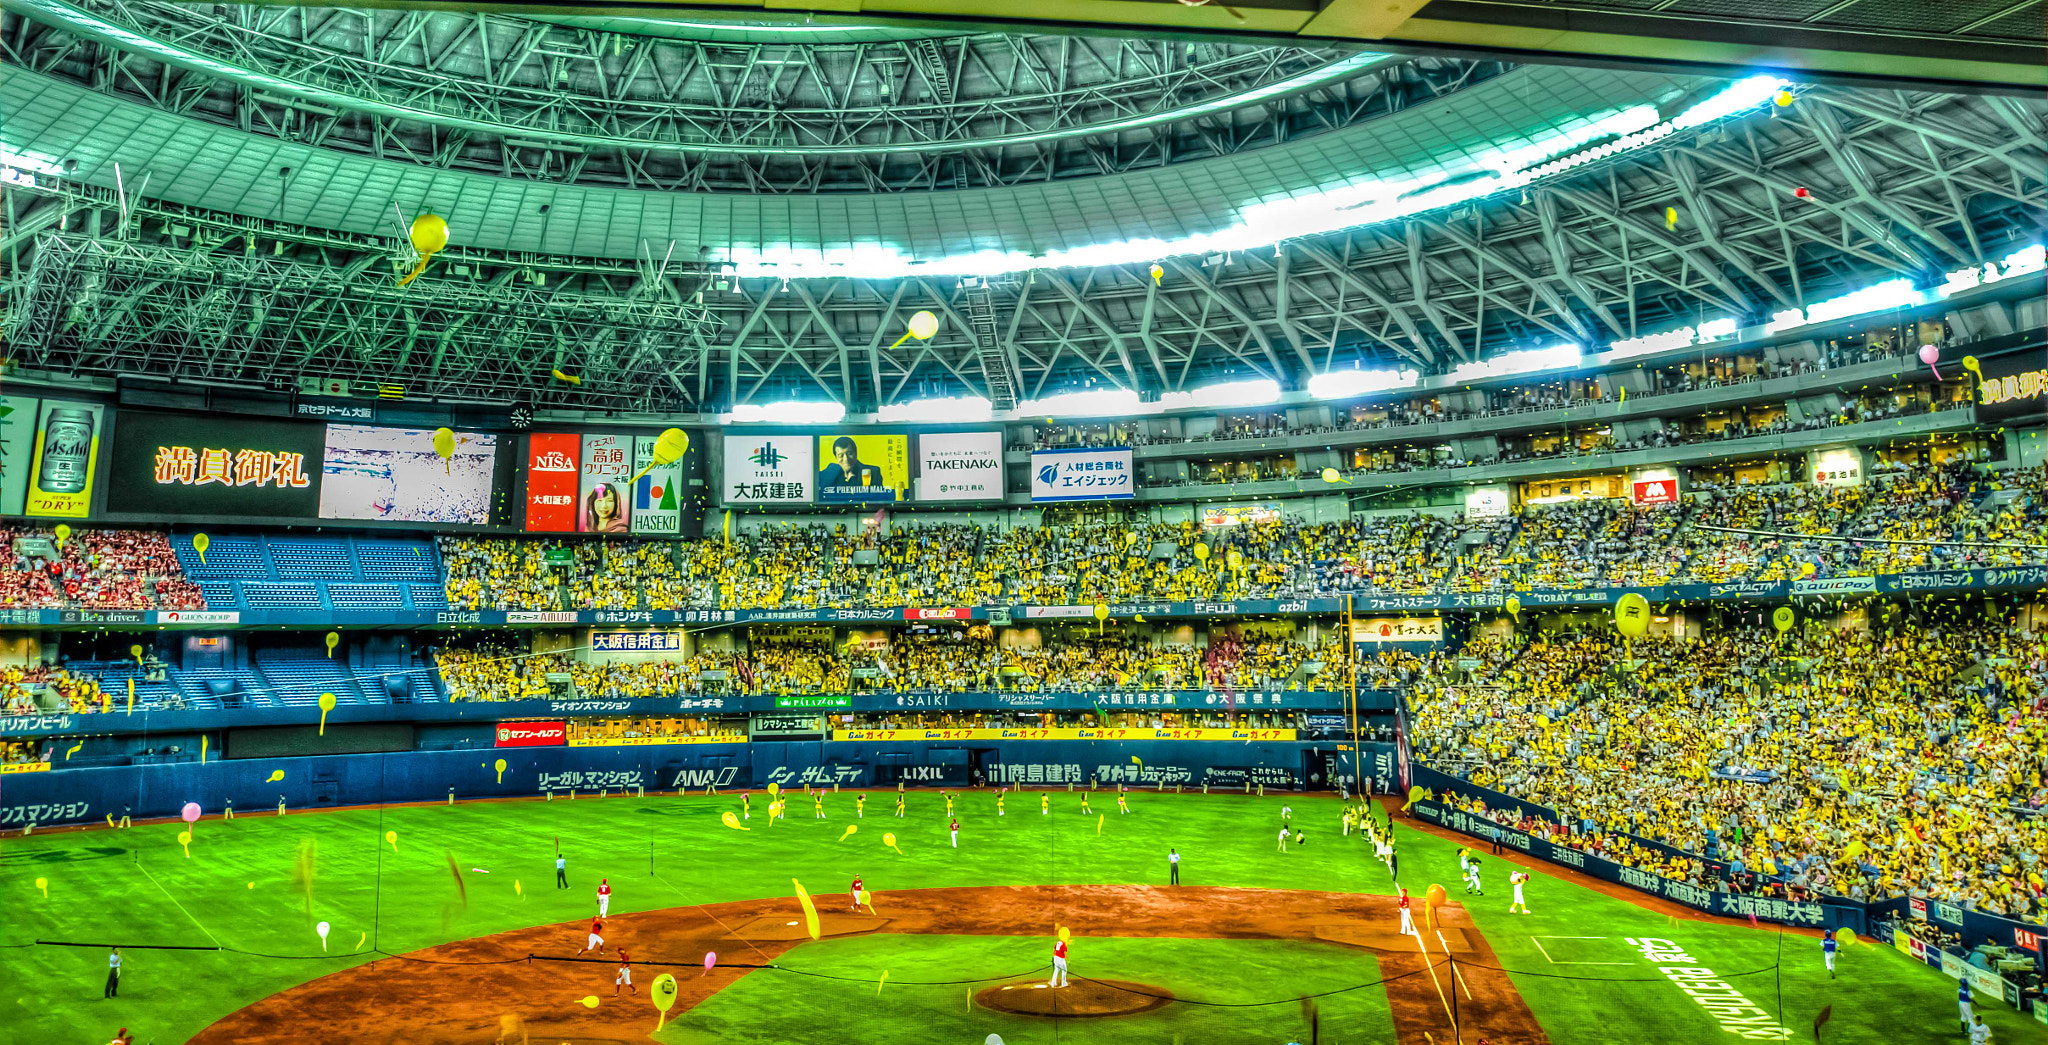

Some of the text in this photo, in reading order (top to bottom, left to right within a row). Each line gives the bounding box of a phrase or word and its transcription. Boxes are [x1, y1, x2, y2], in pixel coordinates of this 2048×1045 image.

[298, 404, 372, 418] 京セラドーム大阪
[47, 439, 88, 457] Asahi
[593, 448, 624, 463] 高須
[155, 446, 310, 488] 満員御礼
[536, 455, 573, 469] NISA
[926, 459, 998, 470] TAKENAKA
[1066, 461, 1124, 472] 人材総合商社
[584, 463, 629, 475] クリニック
[1063, 474, 1128, 487] エイジェック
[734, 482, 804, 499] 大成建設
[836, 485, 870, 494] PREMIUM
[533, 495, 572, 505] 大和証券
[635, 515, 677, 530] HASEKO
[1806, 581, 1874, 590] QUICPay
[1902, 572, 1971, 588] 日本カルミック
[1278, 601, 1308, 612] azbil
[1370, 597, 1441, 608] ファーストステージ
[107, 612, 140, 622] driver.
[205, 612, 231, 621] GROUP
[437, 612, 480, 623] 日立化成
[541, 612, 573, 622] AMUSE
[606, 612, 653, 622] ホシザキ
[838, 610, 895, 619] 日本カルミック
[1394, 624, 1439, 636] 富士火災
[594, 634, 680, 649] 大阪信用金庫
[680, 699, 724, 709] ホーチキ
[793, 697, 834, 706] PALAZZO
[907, 694, 948, 706] SAIKI
[1098, 693, 1174, 705] 大阪信用金庫
[1219, 693, 1282, 705] 大阪祭典
[551, 702, 631, 711] ライオンズマンション
[0, 714, 72, 731] オリオンビール
[866, 731, 896, 740] ガイア
[943, 730, 973, 739] ガイア
[1019, 729, 1049, 738] ガイア
[1096, 729, 1126, 738] ガイア
[1173, 729, 1203, 738] ガイア
[1250, 730, 1280, 739] ガイア
[673, 769, 715, 787] ANA
[904, 766, 944, 780] LIXIL
[1008, 763, 1082, 783] 鹿島建設
[1097, 764, 1139, 782] タカラ
[1618, 866, 1660, 893] 大阪商業大学
[1664, 879, 1712, 909] 大阪商業大学
[1721, 894, 1825, 925] 大阪商業大学
